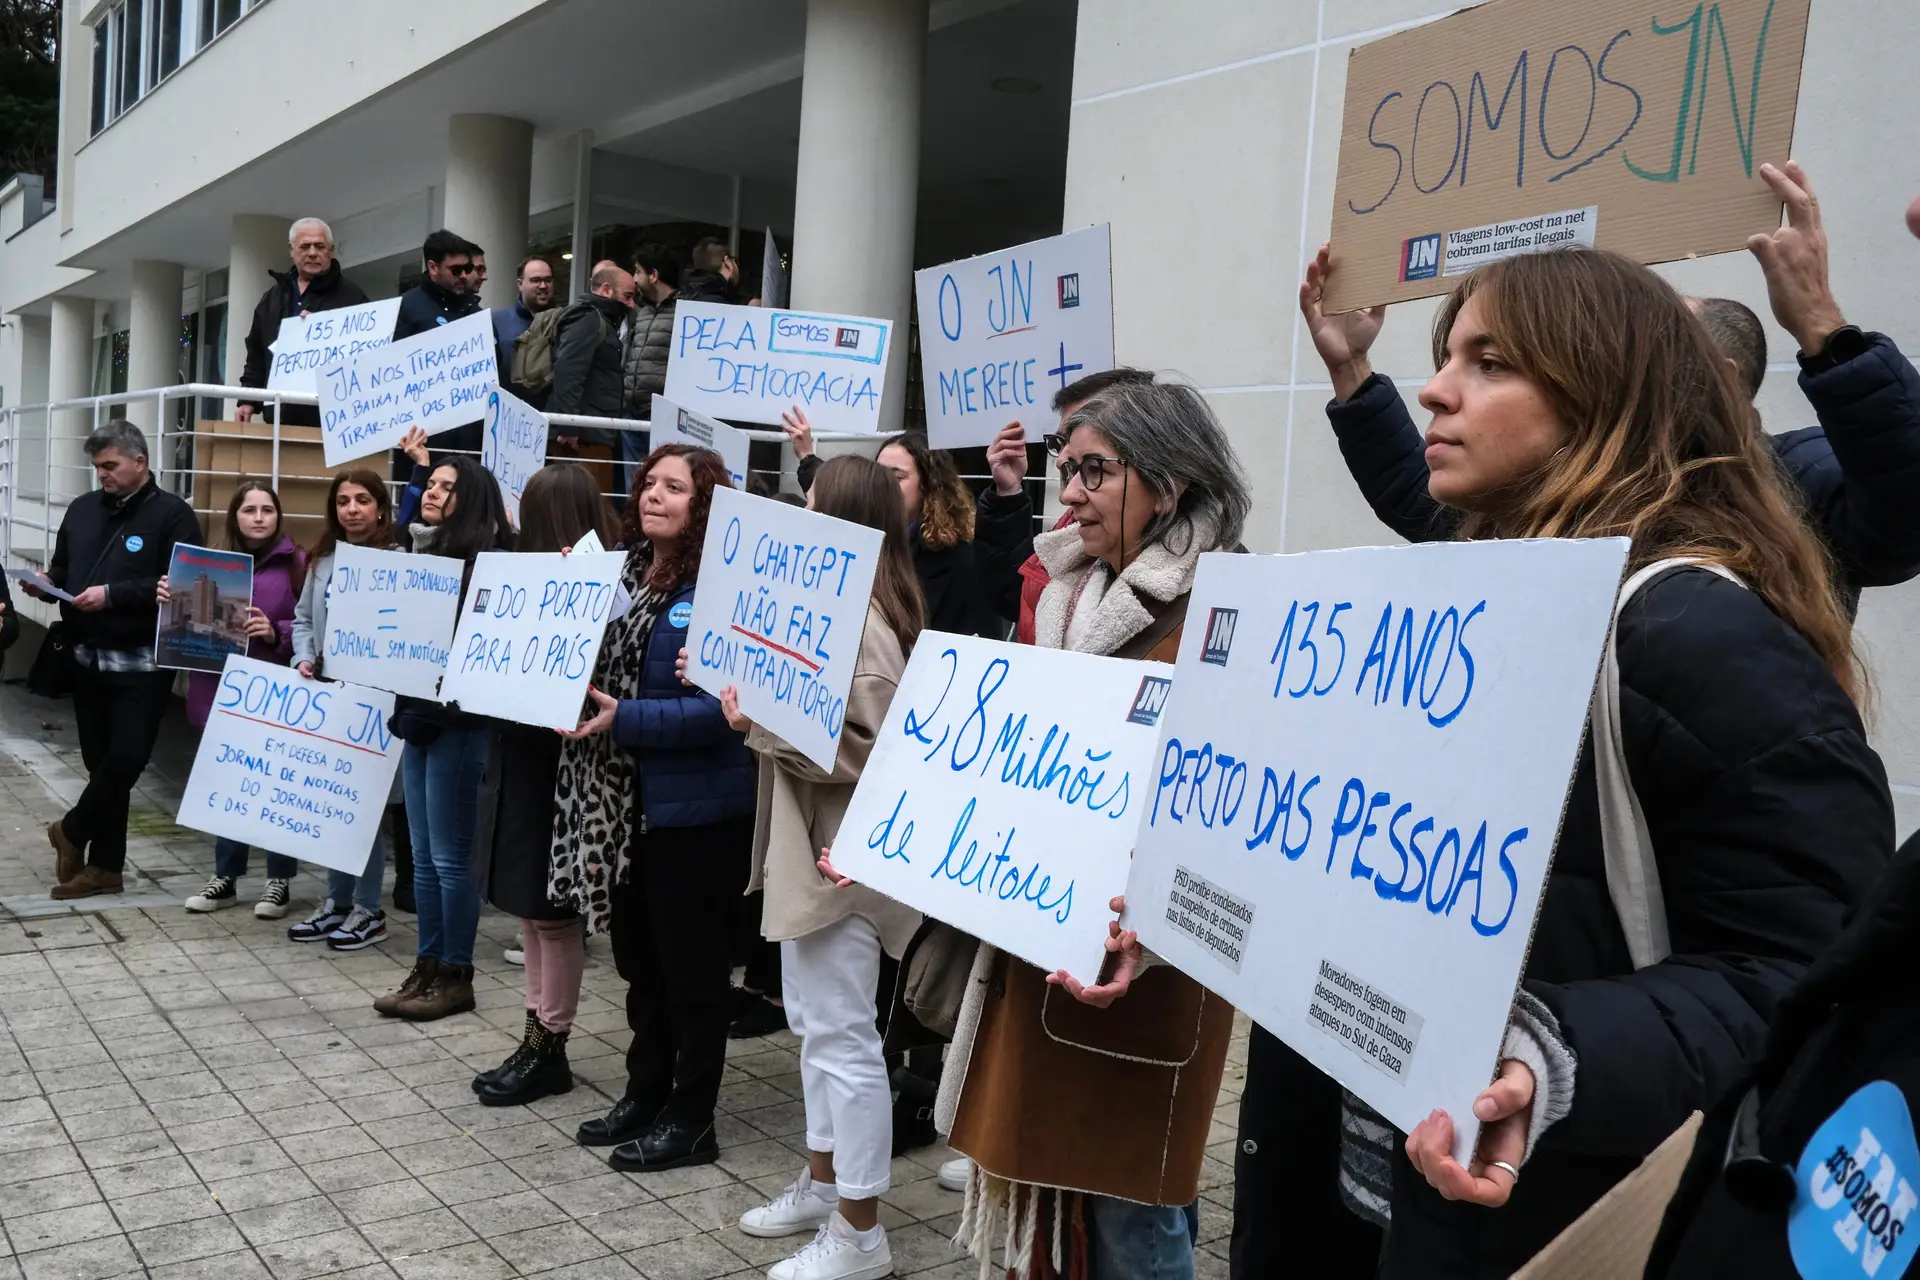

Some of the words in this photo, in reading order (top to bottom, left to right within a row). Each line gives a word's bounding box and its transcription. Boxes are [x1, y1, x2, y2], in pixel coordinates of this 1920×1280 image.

[1348, 29, 1643, 215] SOMOS
[1621, 0, 1776, 183] JN
[1446, 242, 1491, 260] cobram
[1493, 235, 1532, 252] tarifas
[1533, 227, 1576, 245] ilegais
[1449, 228, 1493, 245] Viagens
[1494, 217, 1544, 236] low-cost
[1545, 215, 1562, 228] na
[1564, 210, 1586, 225] net
[1408, 238, 1438, 270] JN
[938, 273, 962, 341] O
[987, 258, 1033, 333] JN
[305, 319, 334, 342] 135
[339, 310, 377, 337] ANOS
[680, 315, 756, 358] PELA
[777, 318, 829, 343] SOMOS
[326, 358, 361, 401] JÁ
[371, 364, 404, 389] NOS
[939, 358, 1036, 416] MERECE
[325, 410, 347, 432] DA
[422, 398, 446, 418] DAS
[338, 566, 360, 593] JN
[369, 568, 397, 593] SEM
[723, 516, 741, 565] O
[753, 533, 857, 597] CHATGPT
[493, 583, 527, 619] DO
[538, 579, 612, 623] PORTO
[731, 585, 777, 637] NÃO
[786, 605, 832, 662] FAZ
[330, 628, 380, 660] JORNAL
[1208, 611, 1237, 651] JN
[460, 632, 512, 675] PARA
[521, 635, 539, 674] O
[542, 632, 592, 680] PAÍS
[1271, 600, 1353, 699] 135
[1356, 599, 1487, 728] ANOS
[217, 668, 332, 731] SOMOS
[347, 702, 394, 751] JN
[1136, 680, 1170, 713] JN
[265, 737, 285, 755] EM
[288, 746, 328, 767] DEFESA
[334, 758, 353, 775] DO
[904, 648, 1009, 772] 2,8
[981, 713, 1130, 819] Milhões
[216, 743, 273, 776] JORNAL
[280, 766, 297, 782] DE
[240, 776, 261, 797] DO
[208, 792, 218, 808] E
[224, 799, 249, 817] DAS
[259, 807, 322, 839] PESSOAS
[1150, 737, 1248, 830] PERTO
[1245, 767, 1321, 862] DAS
[1326, 776, 1529, 937] PESSOAS
[868, 789, 914, 864] de
[930, 796, 1076, 924] leitores
[1170, 890, 1180, 904] ou
[1179, 894, 1211, 921] suspeitos
[1209, 910, 1220, 927] de
[1219, 917, 1244, 942] crimes
[1174, 868, 1189, 888] PSD
[1187, 879, 1211, 901] proíbe
[1210, 891, 1253, 924] condenados
[1165, 907, 1179, 924] nas
[1178, 911, 1196, 934] listas
[1195, 922, 1205, 940] de
[1204, 928, 1241, 962] deputados
[1319, 960, 1364, 998] Moradores
[1363, 985, 1391, 1015] fogem
[1391, 1005, 1407, 1025] em
[1309, 1003, 1341, 1032] ataques
[1340, 1022, 1352, 1040] no
[1351, 1027, 1368, 1050] Sul
[1366, 1038, 1379, 1058] de
[1378, 1045, 1403, 1075] Gaza
[1314, 981, 1356, 1018] desespero
[1355, 1009, 1377, 1031] com
[1375, 1017, 1413, 1055] intensos
[1824, 1145, 1905, 1252] #SOMOS
